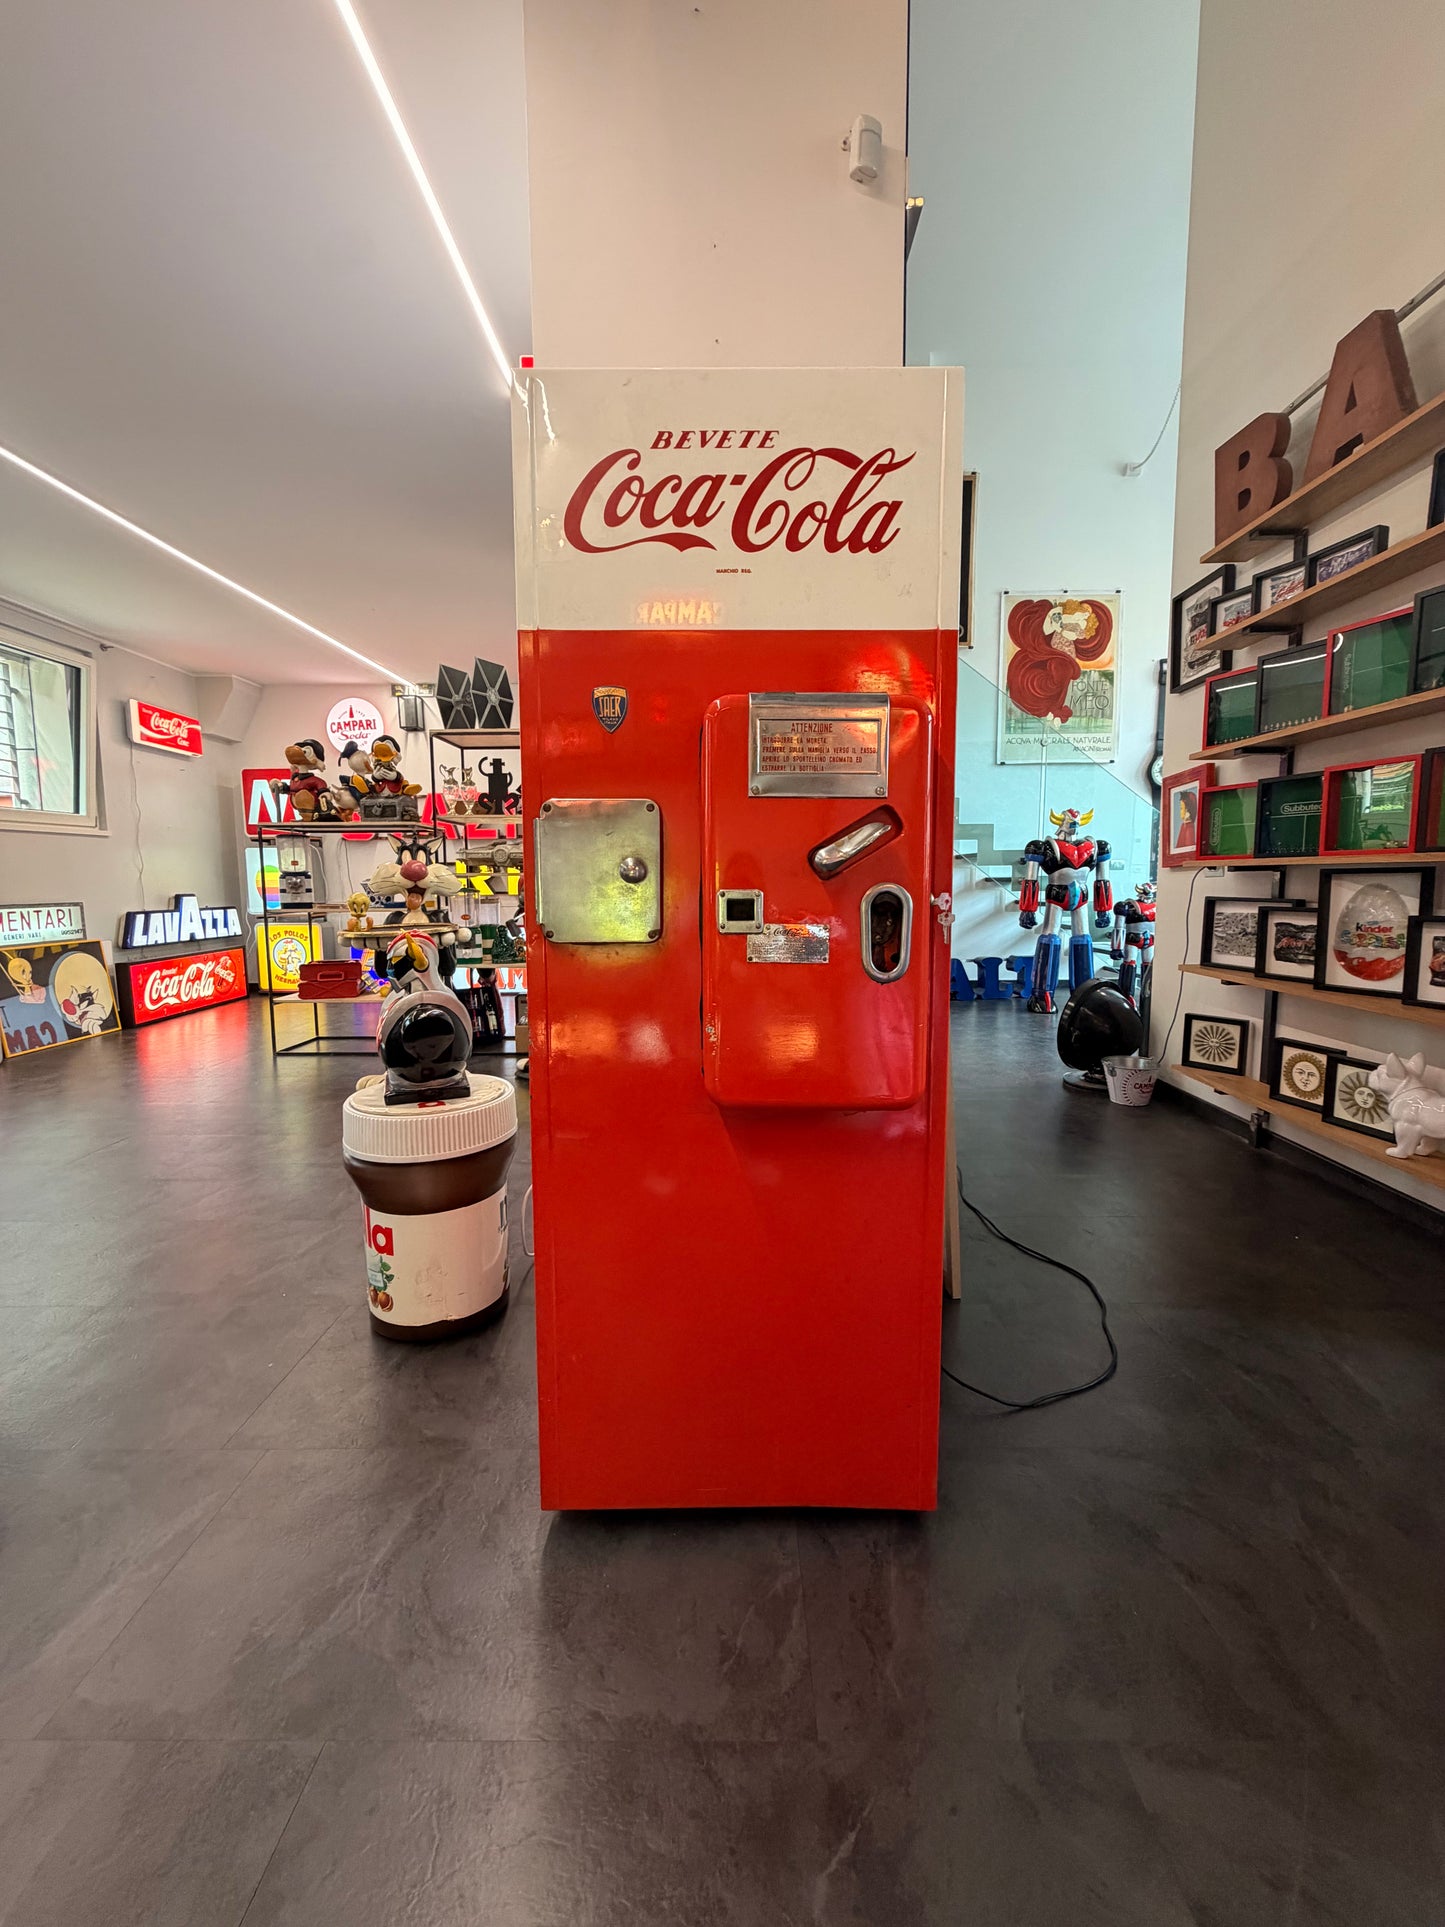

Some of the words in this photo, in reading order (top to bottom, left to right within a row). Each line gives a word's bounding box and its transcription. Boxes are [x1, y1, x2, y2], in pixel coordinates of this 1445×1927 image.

[650, 430, 780, 450] BEVETE
[563, 447, 917, 555] Coca-Cola
[330, 718, 377, 734] CAMPARI
[790, 722, 834, 733] ATTENZIONE
[132, 896, 242, 947] LAVAZZA
[1356, 922, 1394, 933] Kinder
[269, 931, 281, 943] LOS
[144, 960, 217, 1011] Coca-Cola
